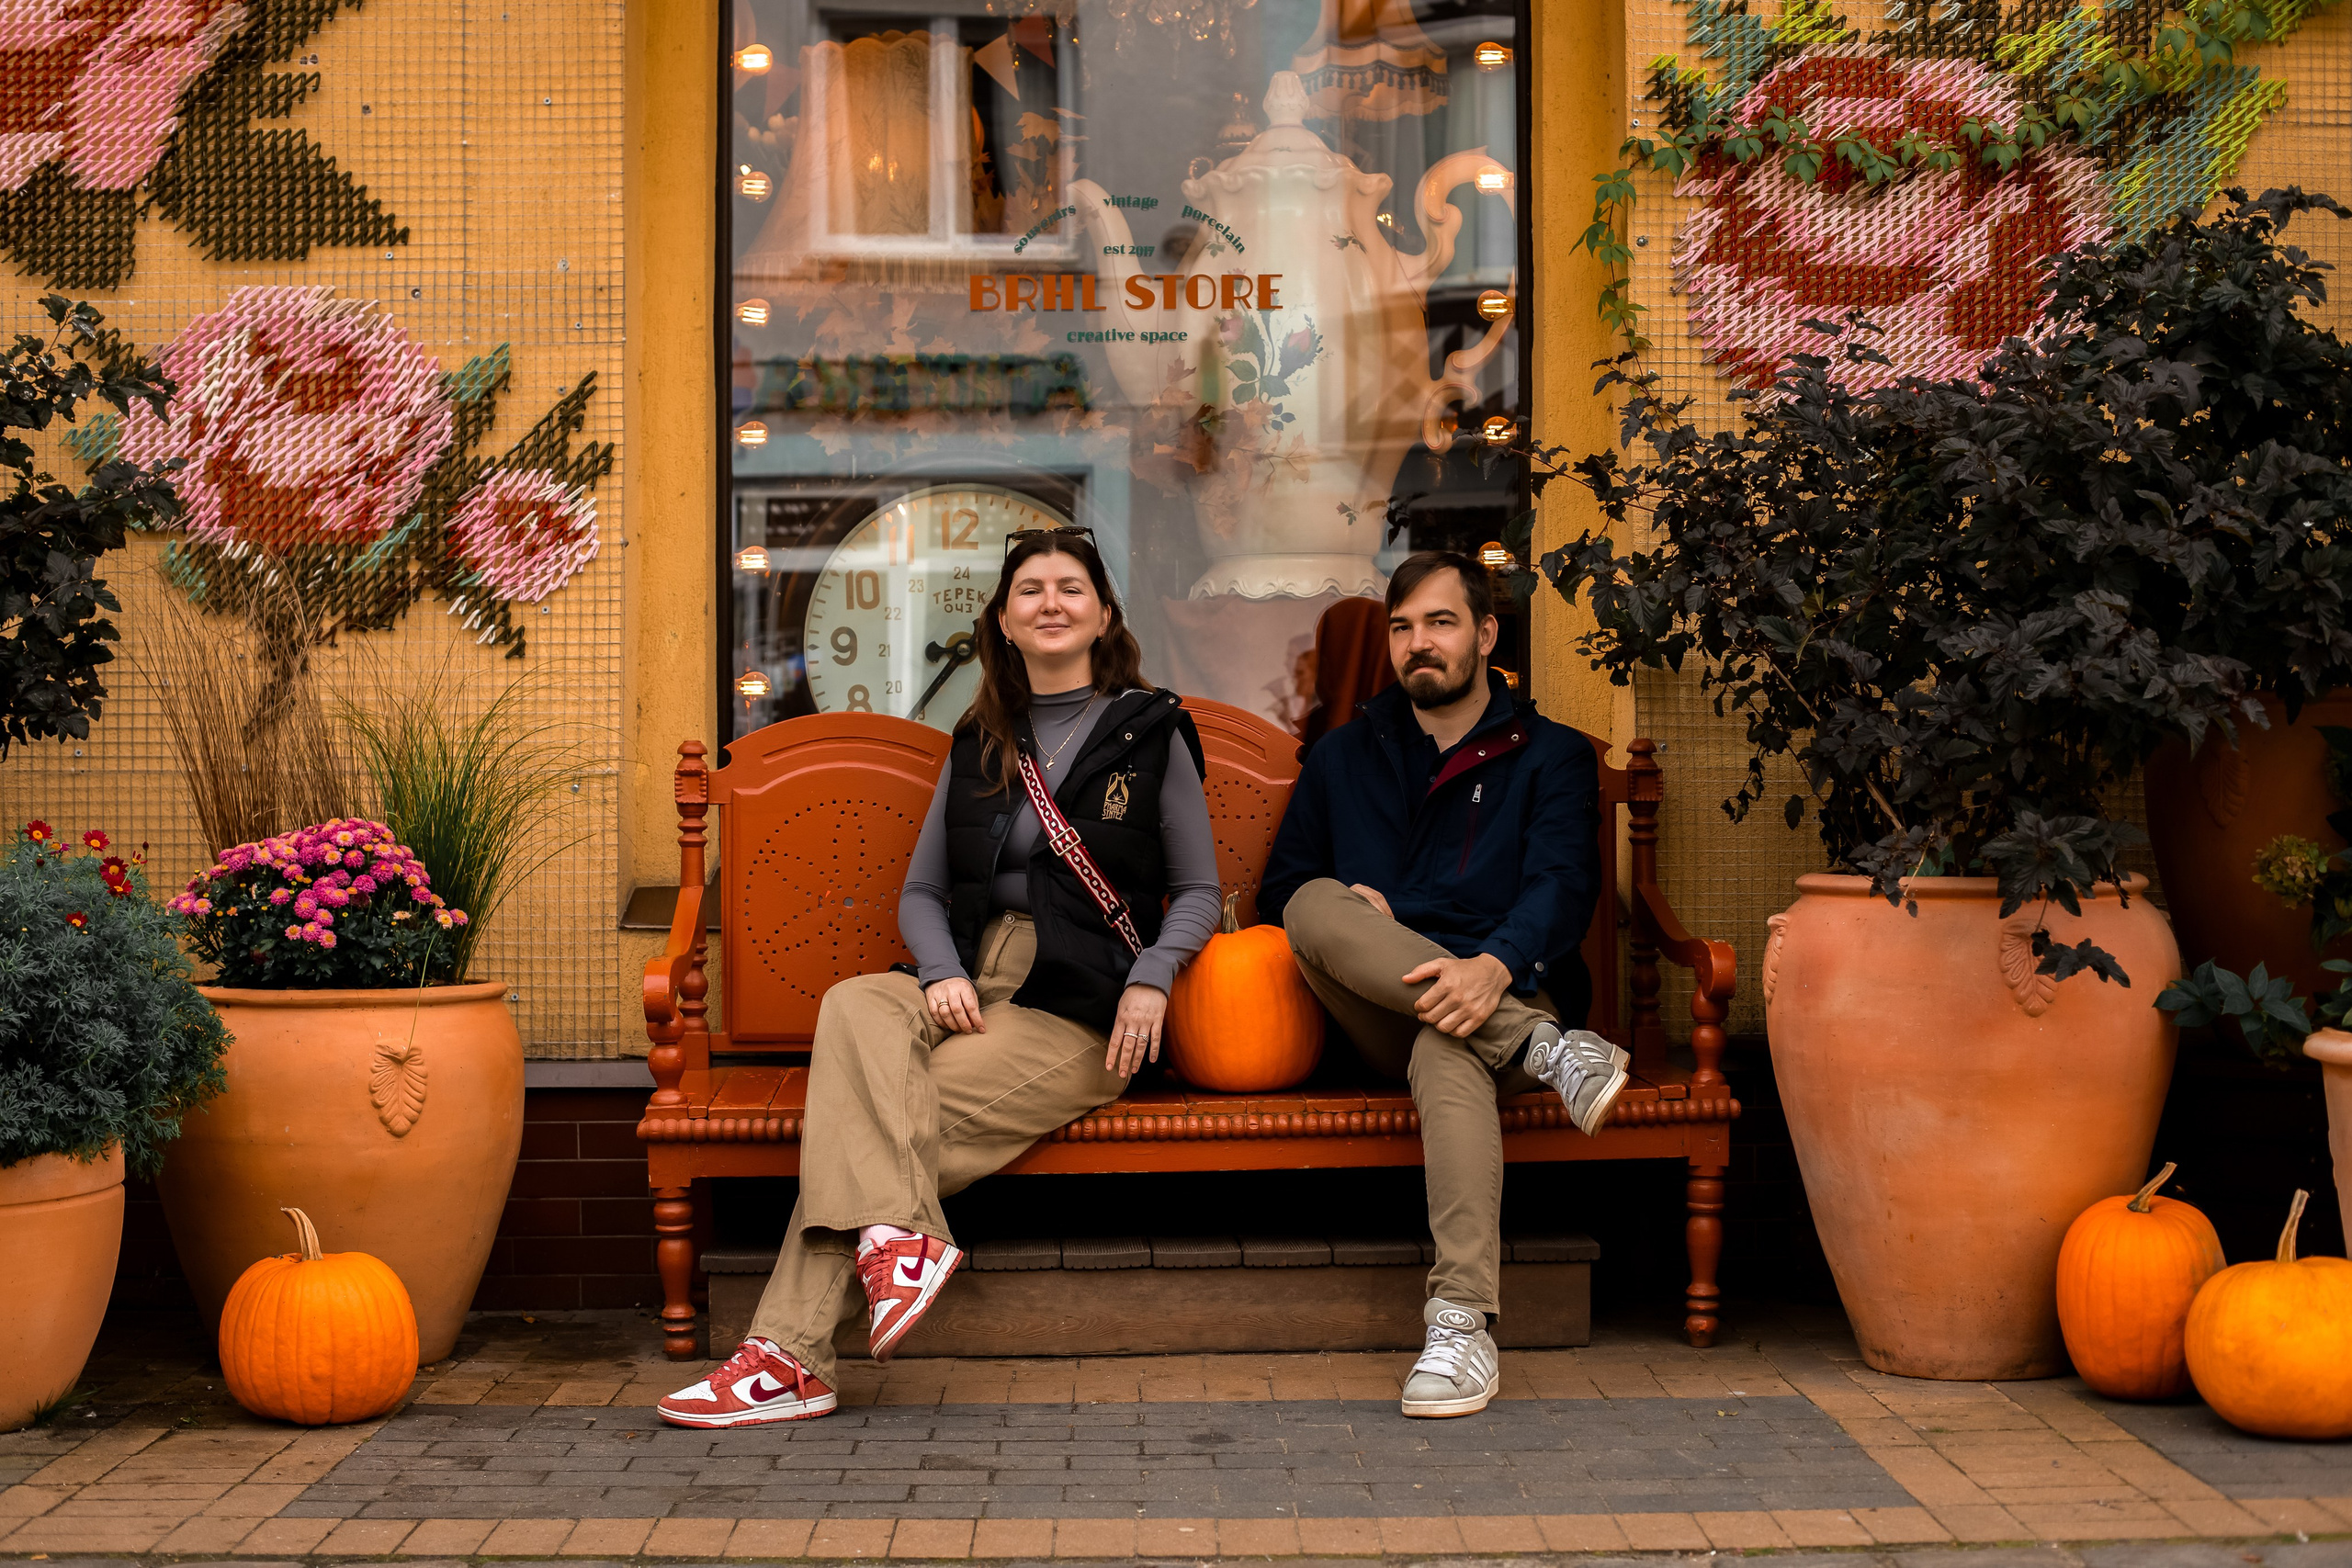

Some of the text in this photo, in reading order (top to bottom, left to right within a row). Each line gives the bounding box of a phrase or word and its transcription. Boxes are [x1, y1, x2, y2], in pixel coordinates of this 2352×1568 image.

[1013, 194, 1246, 254] souvenirs vintage porcelain
[1102, 244, 1156, 257] est 2017
[969, 274, 1283, 311] BRHL STORE
[1067, 329, 1188, 344] creative space
[941, 508, 979, 550] 12
[888, 524, 915, 567] 11
[954, 566, 970, 581] 24
[845, 570, 880, 610] 10
[908, 579, 924, 593] 23
[884, 607, 901, 621] 22
[830, 626, 858, 667] 9
[878, 644, 890, 658] 21
[845, 683, 873, 713] 8
[885, 681, 902, 694] 20
